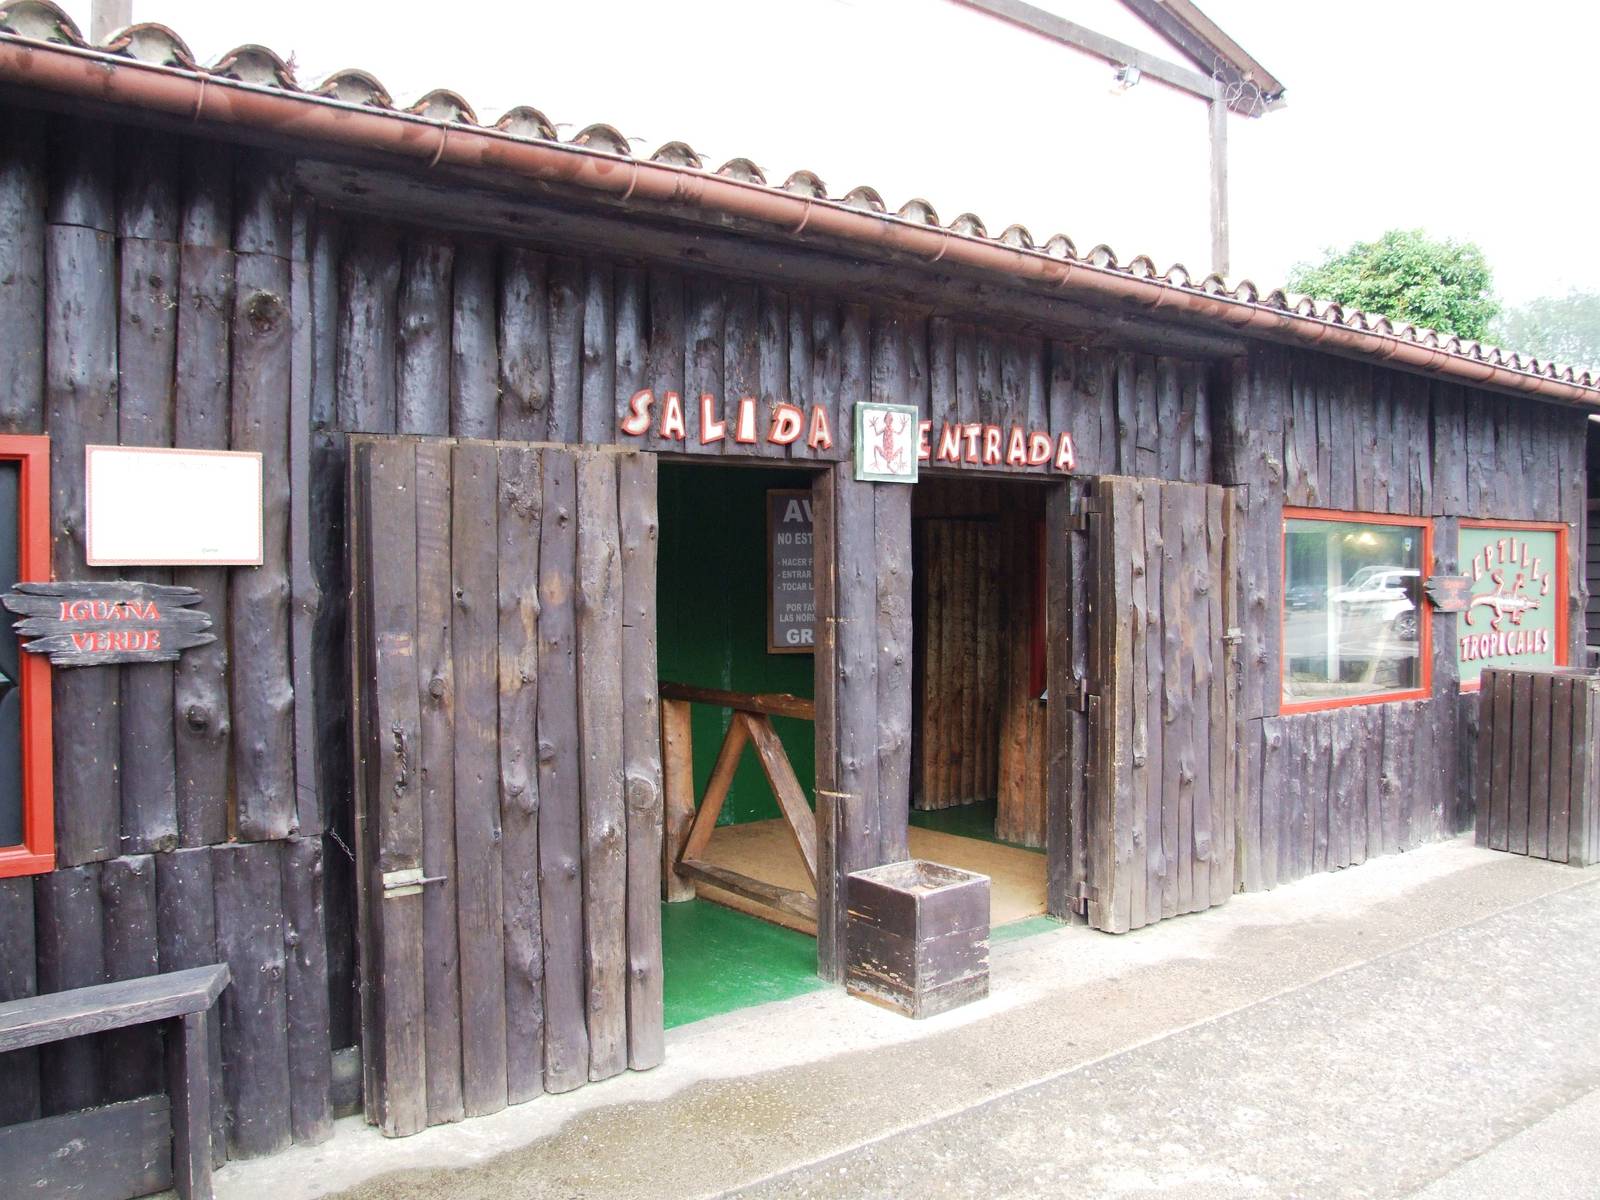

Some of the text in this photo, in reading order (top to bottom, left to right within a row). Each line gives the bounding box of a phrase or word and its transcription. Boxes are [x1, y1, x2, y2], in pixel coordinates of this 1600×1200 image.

[621, 389, 832, 449] SALIDA
[917, 420, 1076, 470] ENTRADA
[777, 532, 792, 545] NO
[782, 558, 807, 567] HACER
[1461, 537, 1550, 596] EPTILES
[782, 570, 812, 579] ENTRAR
[782, 582, 807, 591] TOCAR
[59, 599, 160, 622] IGUANA
[786, 603, 801, 612] POR
[779, 614, 794, 623] LAS
[70, 630, 160, 652] VERDE
[1460, 629, 1549, 662] TROPICALES
